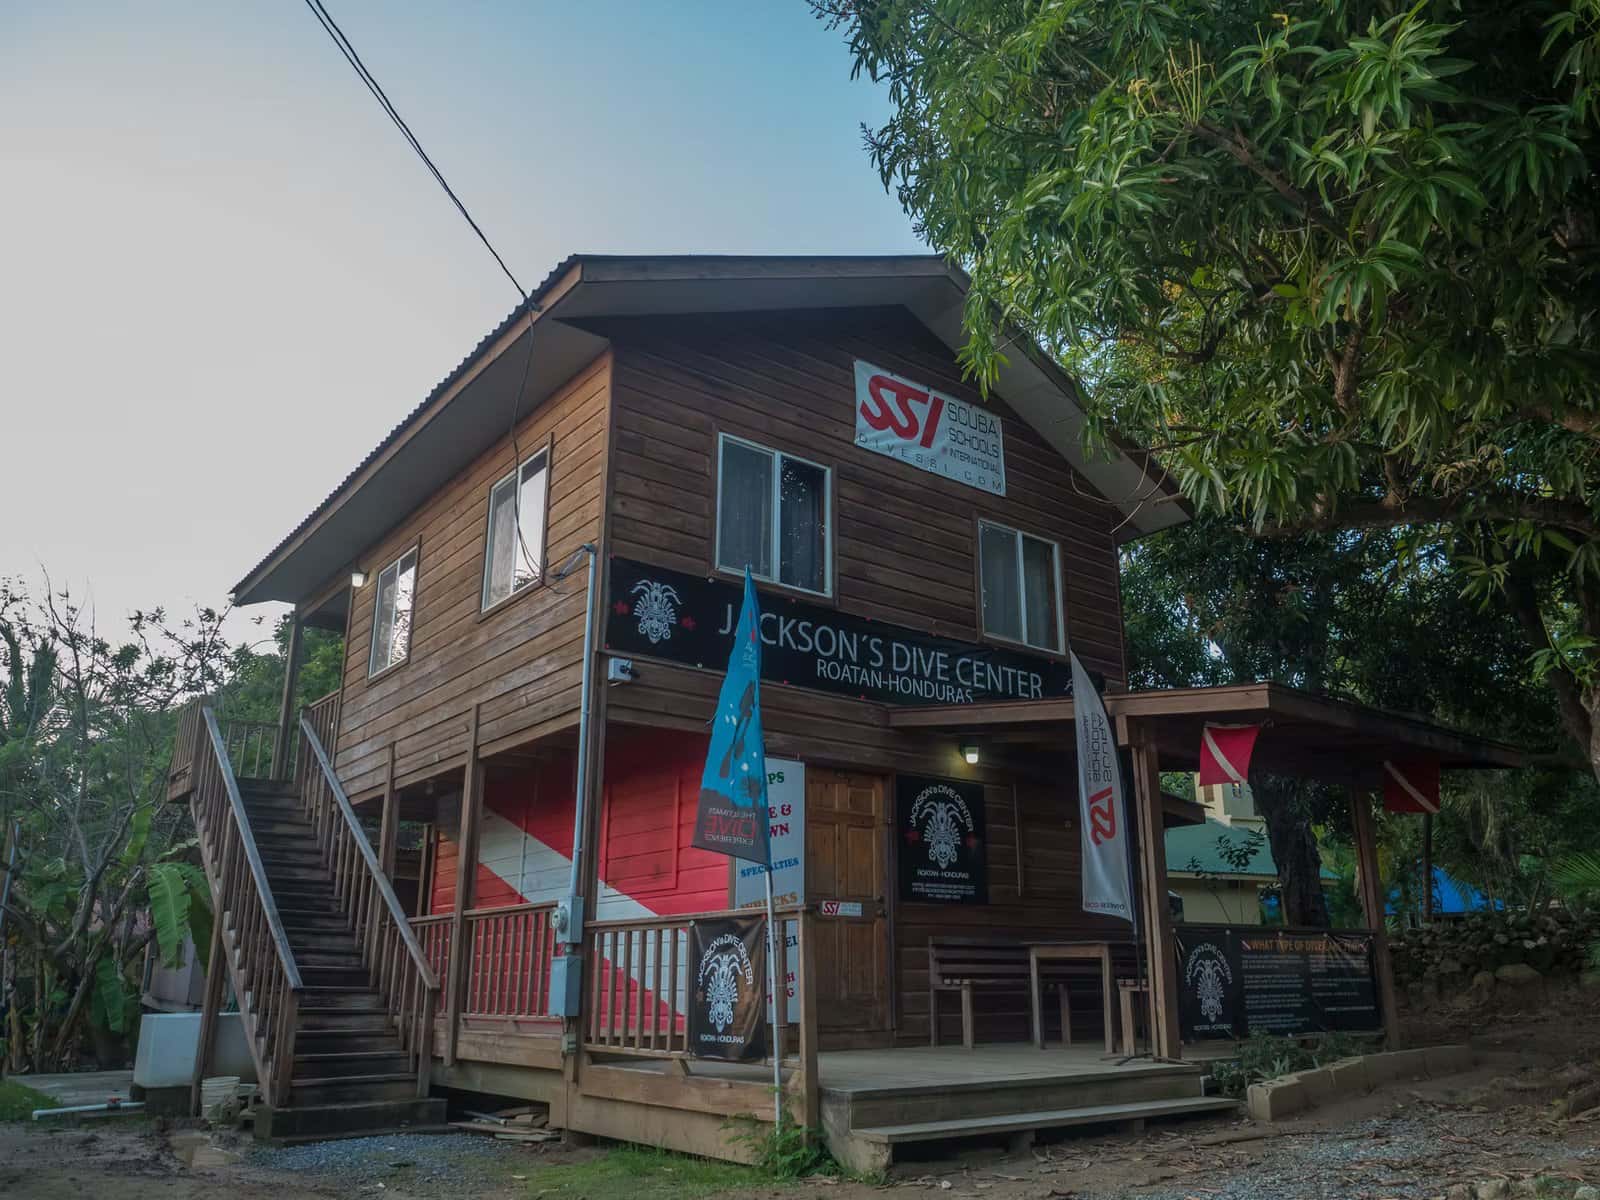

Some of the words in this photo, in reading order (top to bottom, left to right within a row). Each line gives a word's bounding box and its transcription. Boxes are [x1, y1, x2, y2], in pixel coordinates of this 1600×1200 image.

[860, 375, 945, 448] SSI
[947, 402, 999, 439] SCUBA
[948, 427, 1000, 459] SCHOOLS
[949, 447, 1001, 476] INTERNATIONAL
[718, 603, 884, 667] JCKSON'S
[892, 641, 950, 682] DIVE
[955, 656, 1043, 699] CENTER
[816, 658, 974, 704] ROATAN-HONDURAS
[938, 784, 955, 799] DIVE
[723, 933, 740, 948] DIVE
